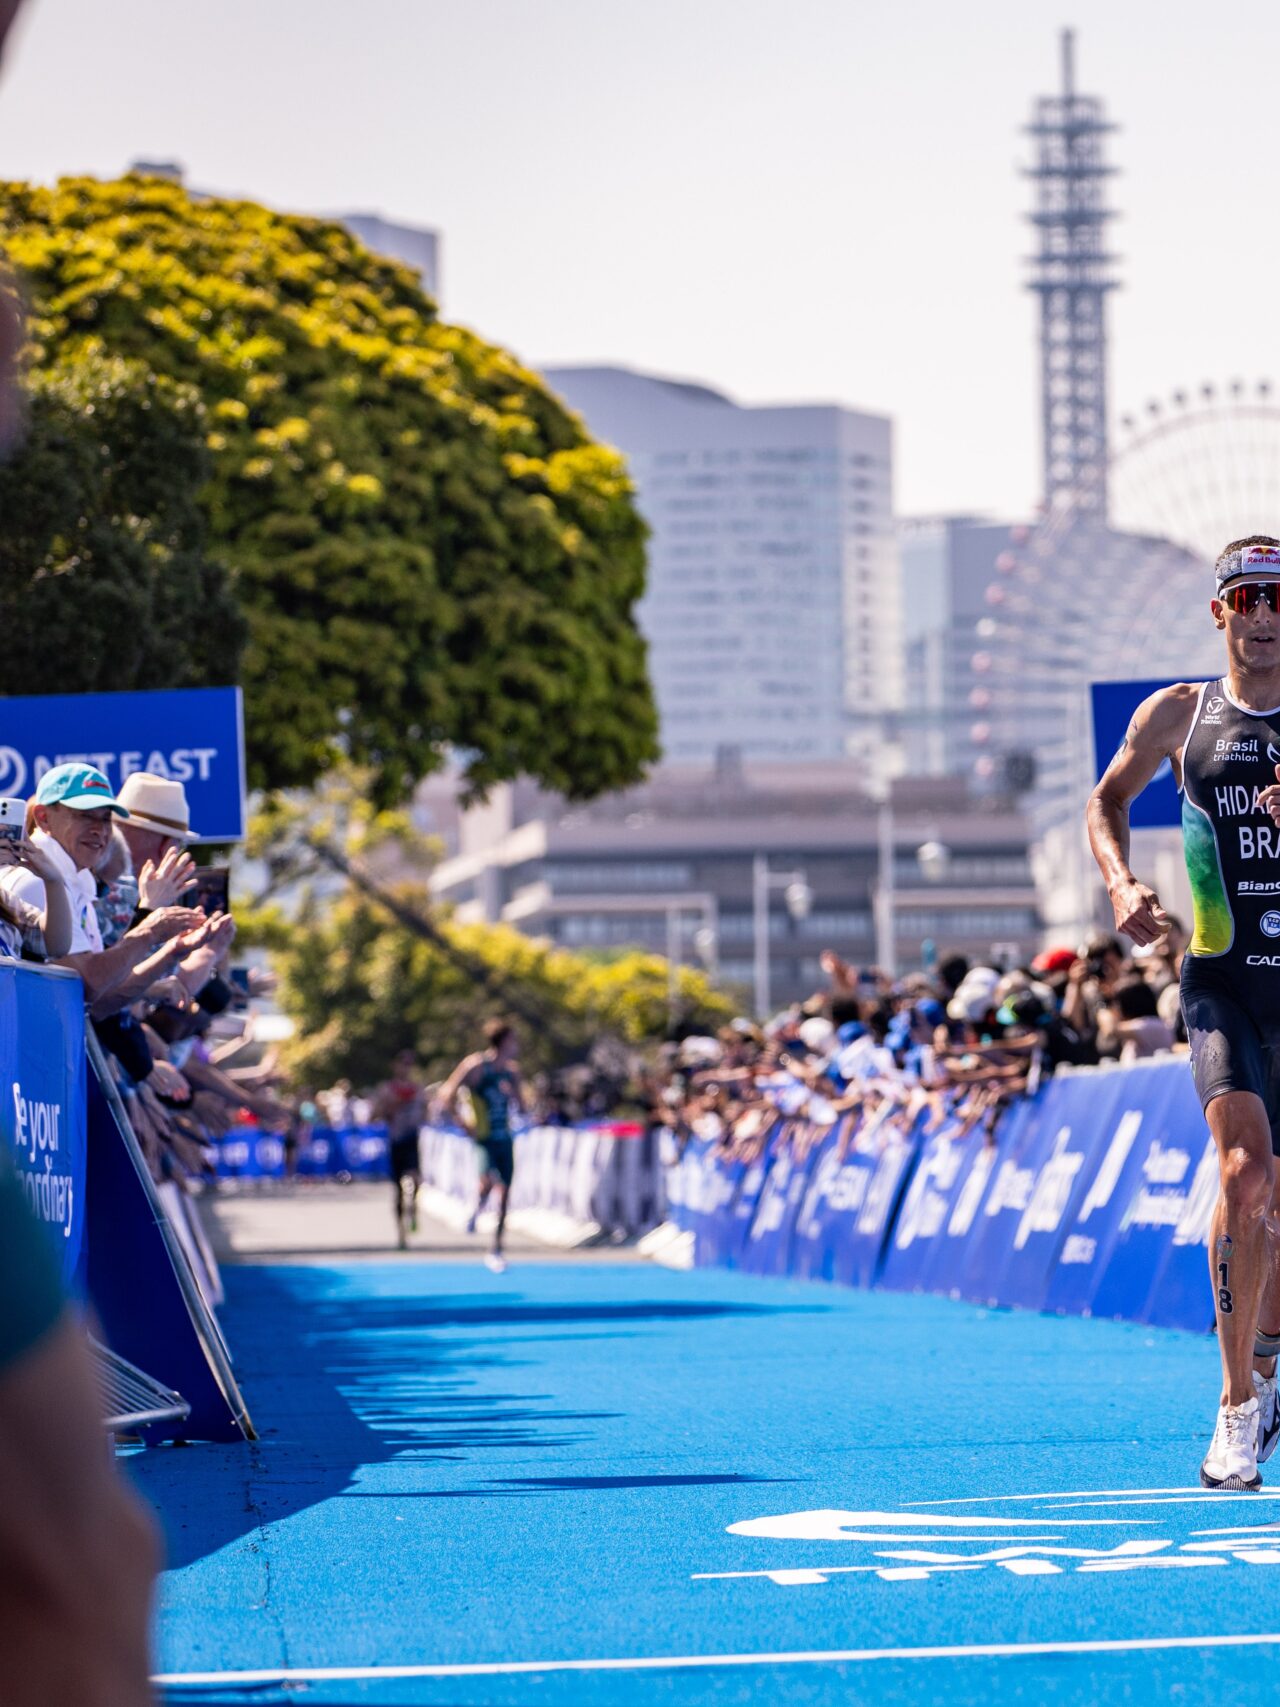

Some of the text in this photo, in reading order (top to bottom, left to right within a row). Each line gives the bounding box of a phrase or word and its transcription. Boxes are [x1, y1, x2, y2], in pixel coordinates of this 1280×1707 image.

[1265, 556, 1280, 564] Bull
[1216, 739, 1258, 752] Brasil
[1213, 753, 1258, 763] triathlon
[29, 1100, 60, 1163] your
